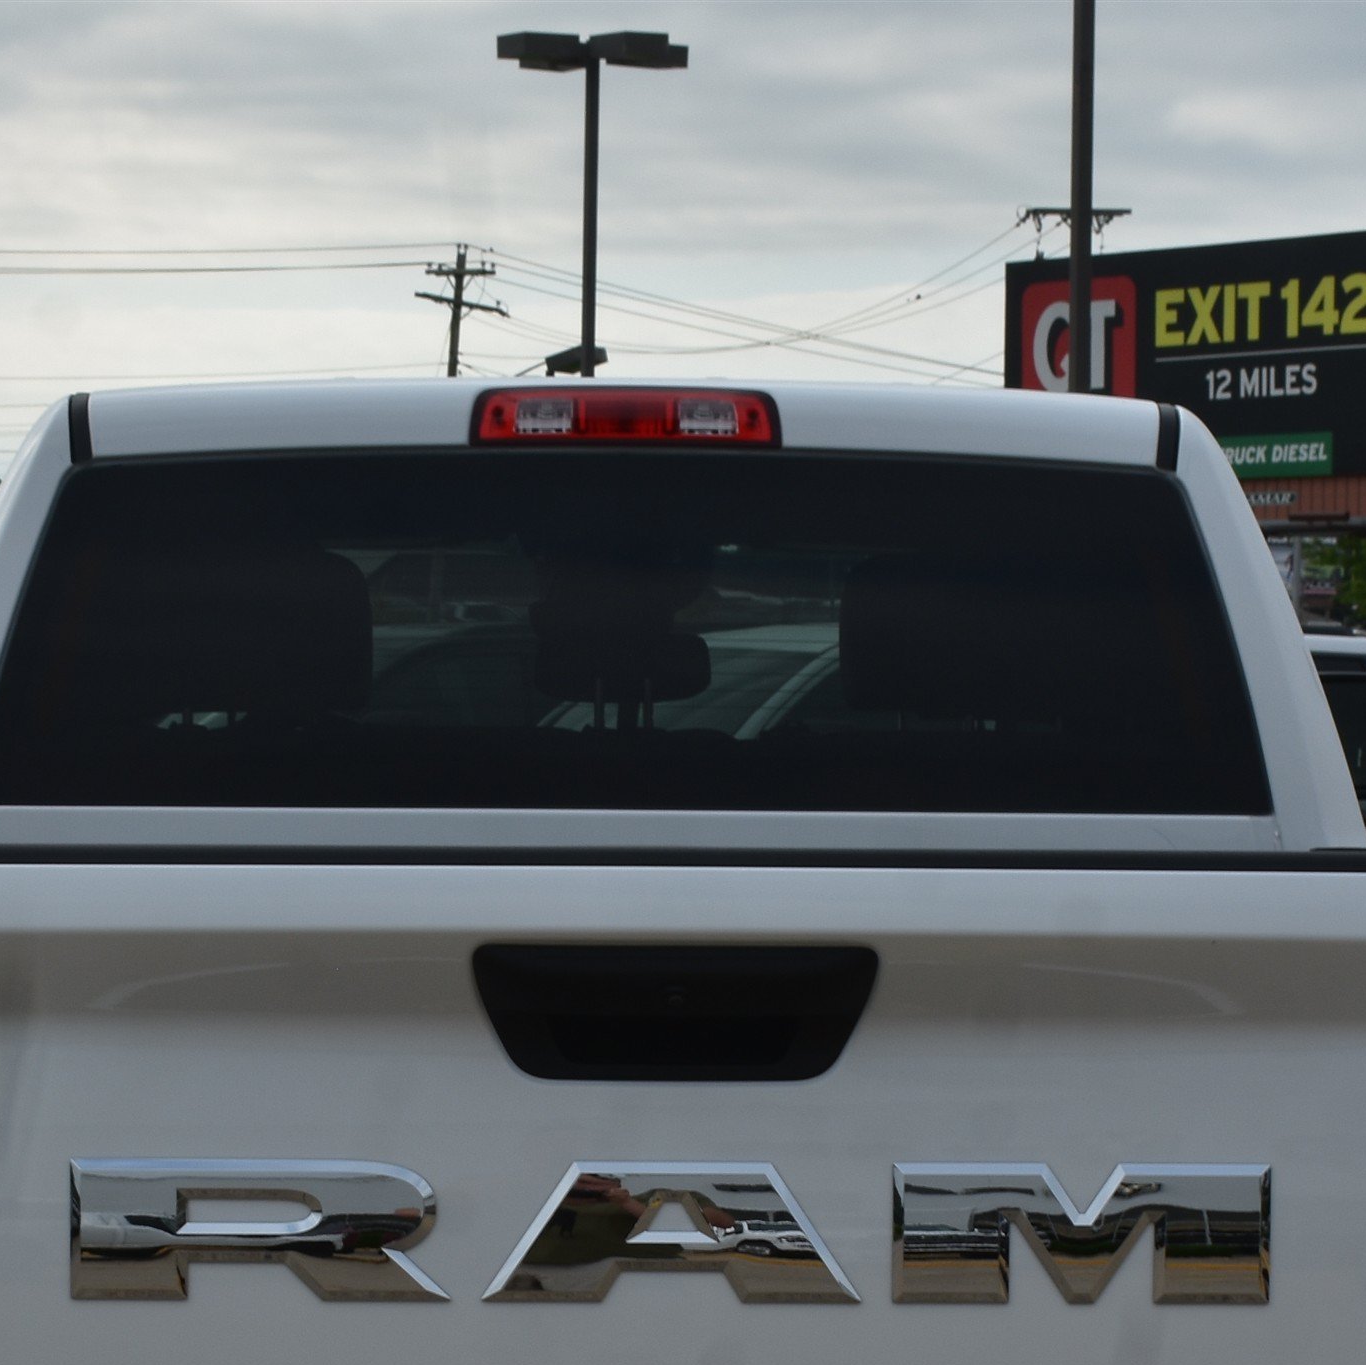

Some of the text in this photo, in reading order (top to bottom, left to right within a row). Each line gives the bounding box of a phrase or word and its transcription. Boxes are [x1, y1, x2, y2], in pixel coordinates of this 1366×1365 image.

[1155, 281, 1271, 348] EXIT
[1205, 363, 1318, 400] 12 MILES
[1223, 442, 1328, 465] RUCK DIESEL
[70, 1157, 1271, 1305] RAM
